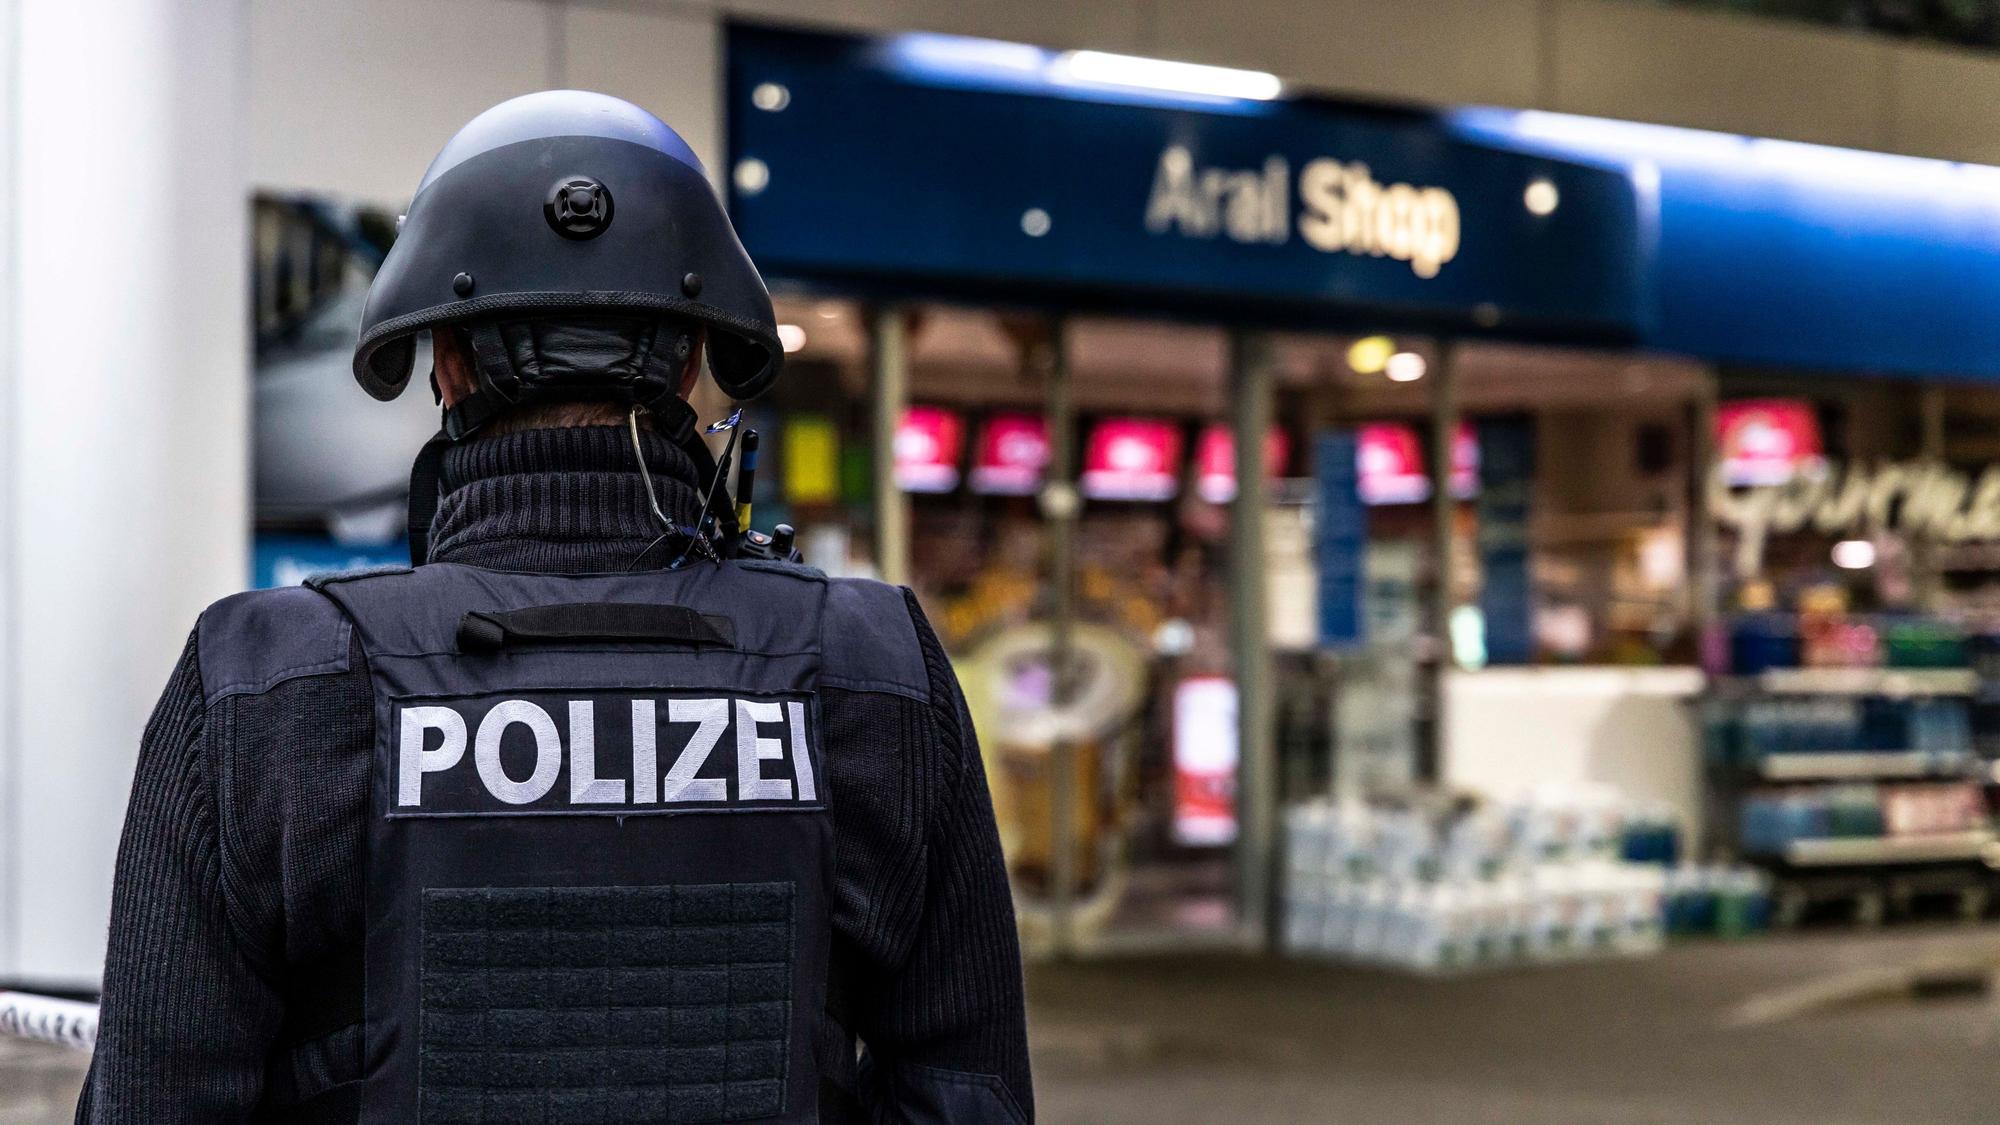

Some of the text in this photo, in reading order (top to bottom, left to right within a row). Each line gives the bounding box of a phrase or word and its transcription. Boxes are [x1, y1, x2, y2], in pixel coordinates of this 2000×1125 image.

[1144, 146, 1461, 279] Aral Shop
[399, 699, 817, 806] POLIZEI
